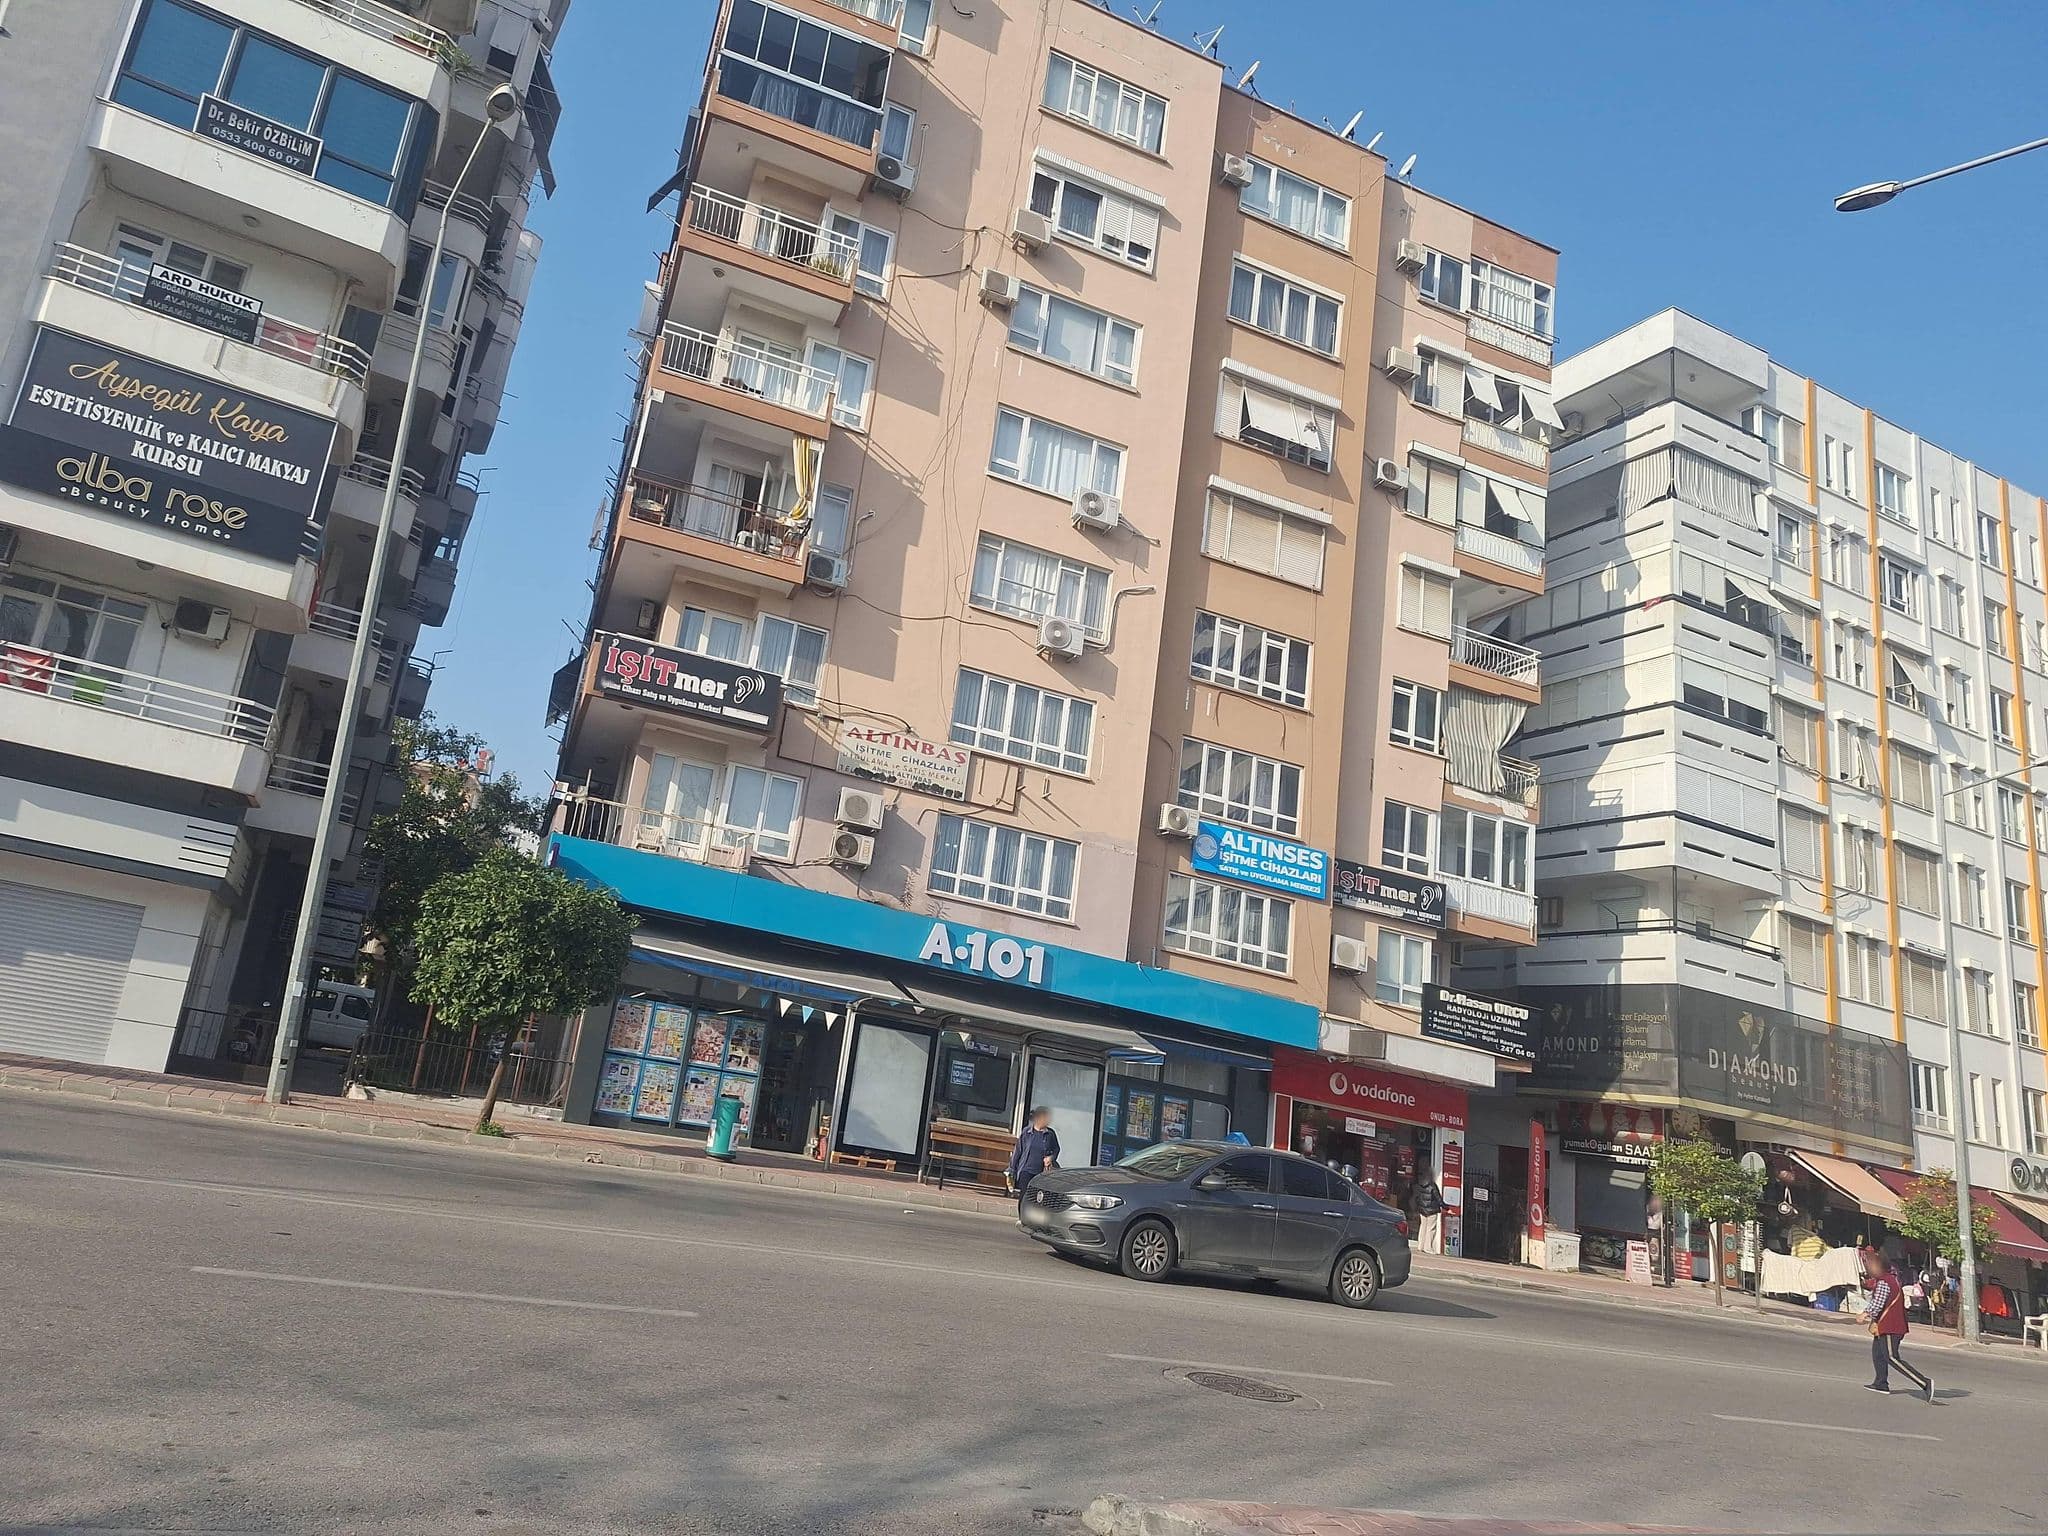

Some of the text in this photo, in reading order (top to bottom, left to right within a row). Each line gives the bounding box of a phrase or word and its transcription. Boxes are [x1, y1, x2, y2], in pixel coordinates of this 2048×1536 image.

[208, 104, 225, 122] Dr.
[228, 113, 261, 136] Bekir
[212, 126, 301, 166] 0533 400 60 07
[160, 270, 255, 310] ARD HUKUK
[68, 359, 290, 443] Ayşegül Kaya
[28, 384, 311, 486] ESTETİSYENLİK ve KALICI MAKYAJ
[131, 440, 203, 477] KURSU
[56, 452, 249, 530] alba rose
[69, 486, 222, 539] Beauty Home
[846, 726, 967, 767] ALTINBAŞ
[1220, 847, 1322, 884] İŞİTME CİHAZLARI
[1221, 830, 1323, 870] ALTINSES
[1490, 1013, 1521, 1028] UZMANI
[1500, 1044, 1514, 1054] 247
[1515, 1048, 1525, 1056] 04
[1542, 1036, 1599, 1053] AMOND
[1708, 1048, 1798, 1087] DIAMOND
[1352, 1083, 1416, 1107] vodafone
[1533, 1136, 1541, 1200] vodafone
